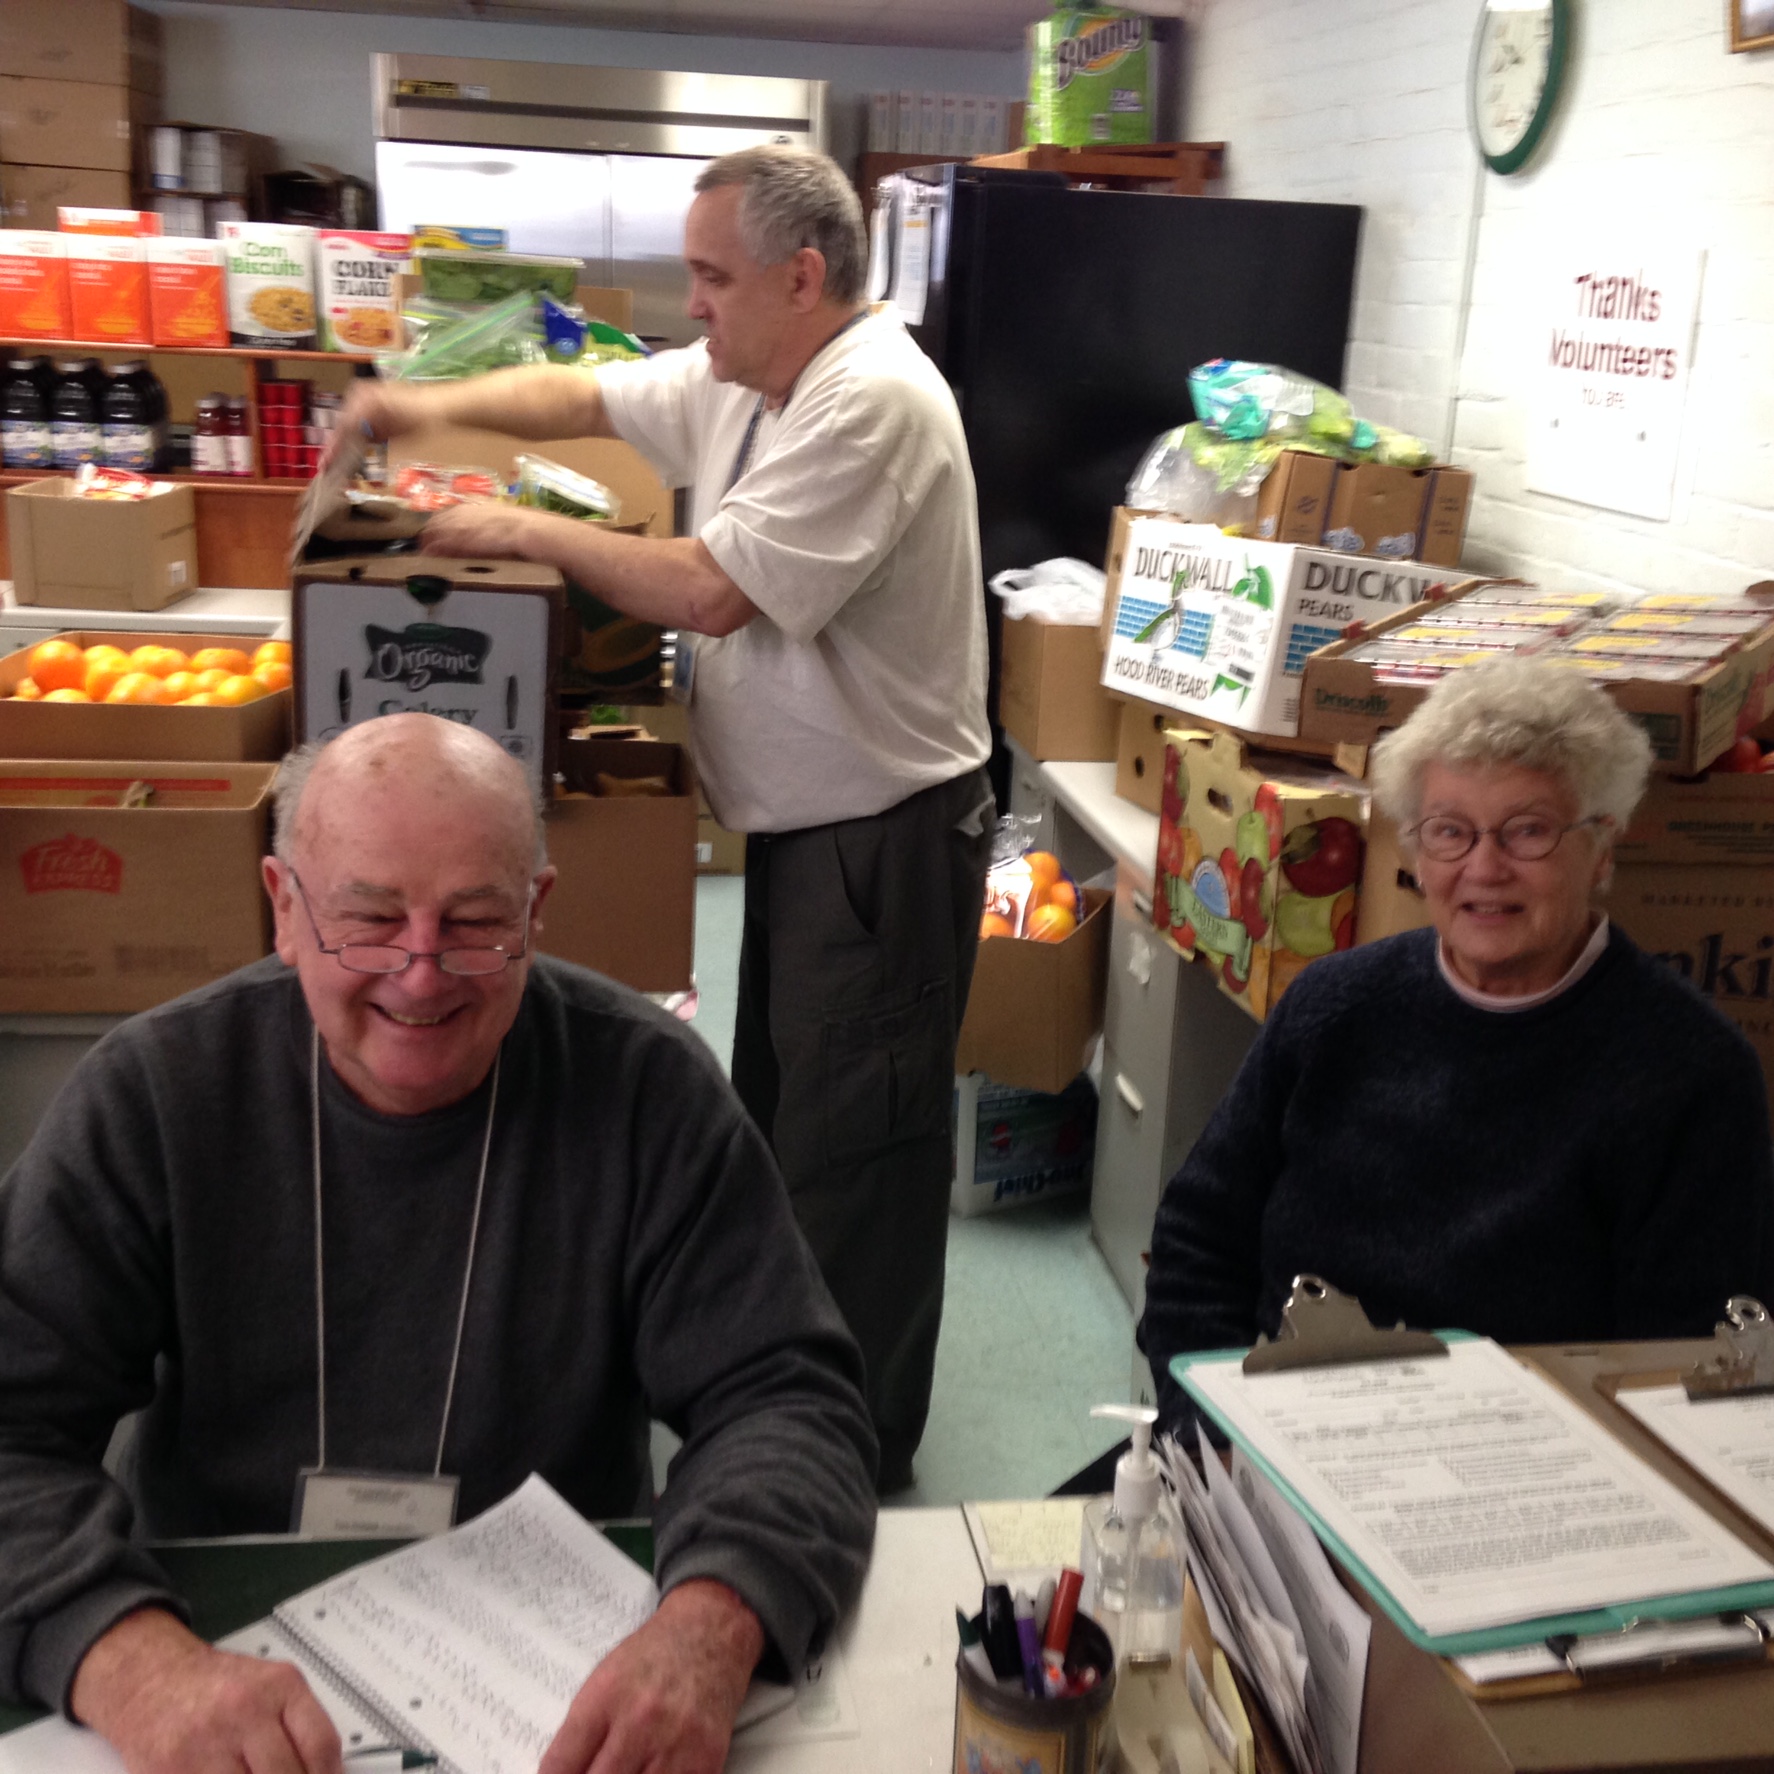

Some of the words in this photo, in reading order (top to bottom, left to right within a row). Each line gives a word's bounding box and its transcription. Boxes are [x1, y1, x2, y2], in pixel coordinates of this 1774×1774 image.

[230, 257, 304, 276] Biscuits
[242, 241, 287, 258] Corn
[1573, 268, 1662, 322] Thanks
[1548, 328, 1678, 380] Volunteers
[1134, 547, 1234, 592] DUCKWALL
[1299, 598, 1354, 621] PEARS
[378, 643, 479, 692] Organic
[1115, 655, 1145, 680] HOOD
[1146, 663, 1175, 690] RIVER
[1176, 671, 1209, 700] PEARS
